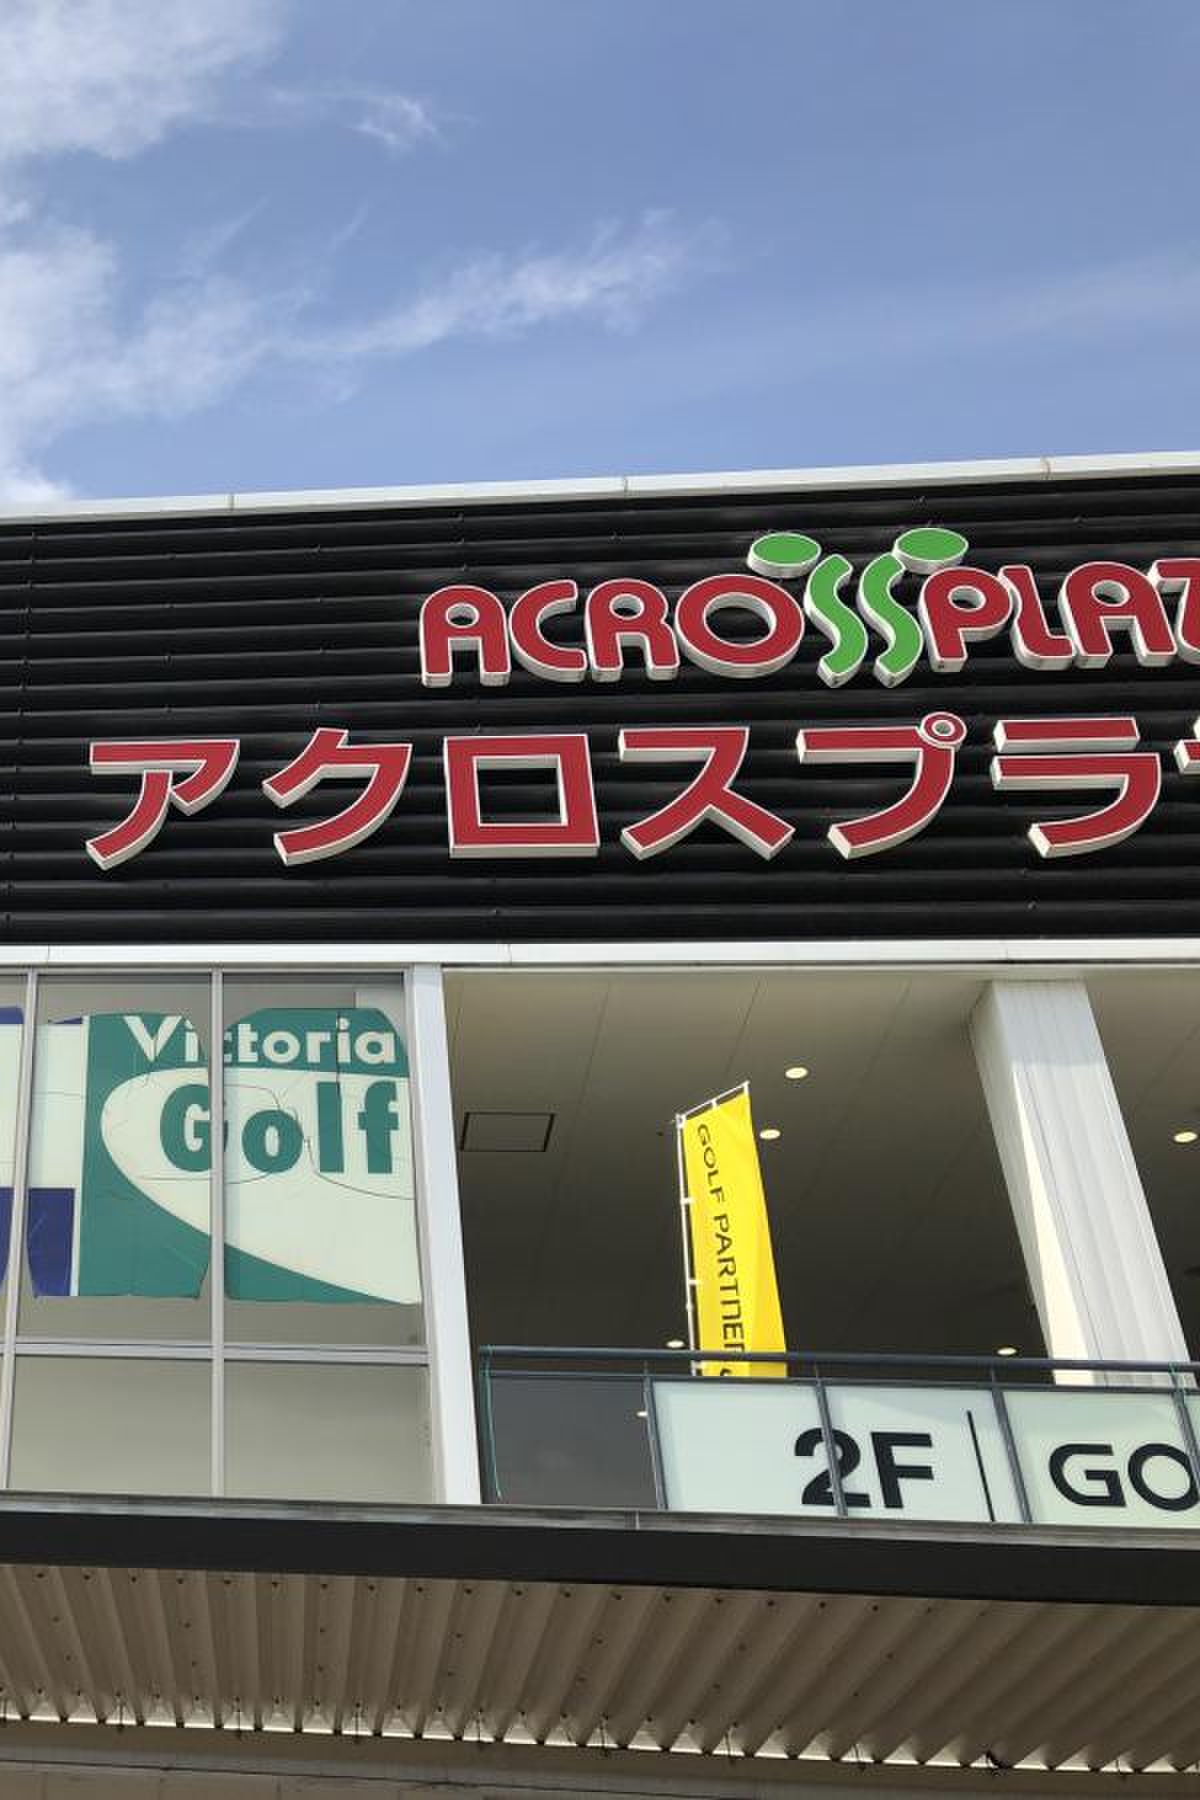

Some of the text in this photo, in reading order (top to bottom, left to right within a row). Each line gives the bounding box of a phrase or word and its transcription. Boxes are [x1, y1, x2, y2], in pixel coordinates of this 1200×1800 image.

[86, 712, 1200, 870] アクロスプラ
[159, 1081, 400, 1175] Golf
[697, 1123, 726, 1204] GOLF
[794, 1427, 935, 1509] 2F
